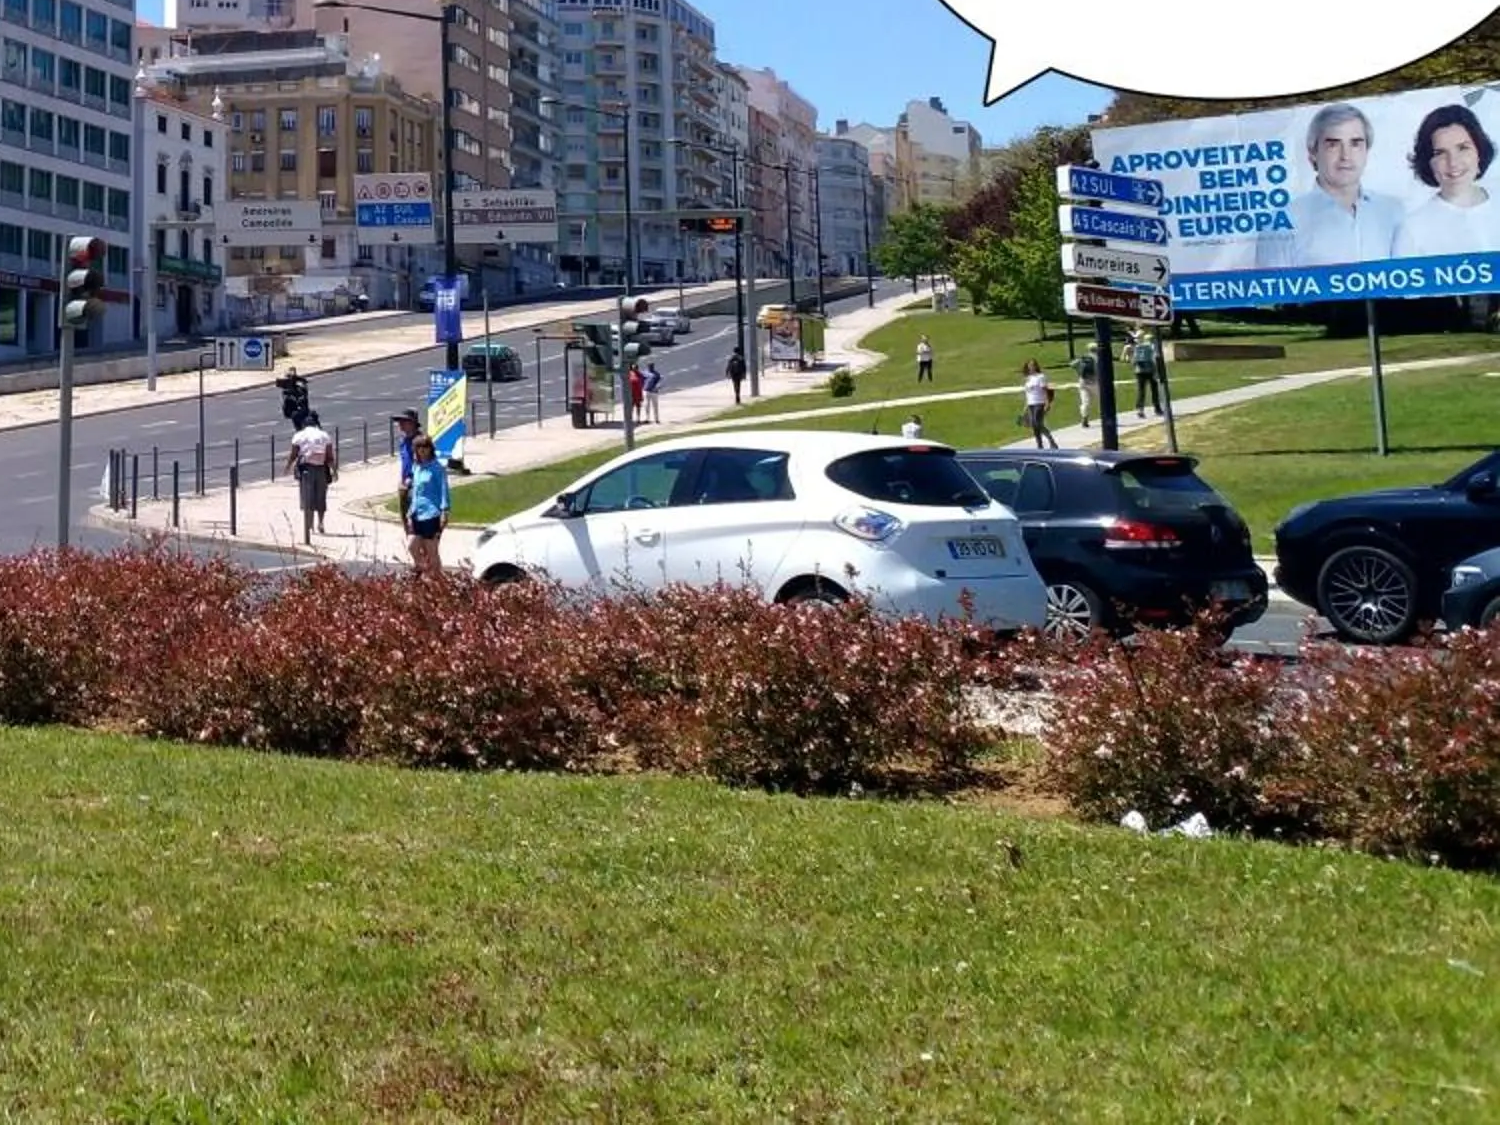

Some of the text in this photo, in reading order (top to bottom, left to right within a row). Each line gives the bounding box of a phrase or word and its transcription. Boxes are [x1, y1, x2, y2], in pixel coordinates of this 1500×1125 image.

[1110, 141, 1286, 174] APROVEITAR
[1072, 174, 1117, 196] A2 SUL
[1200, 164, 1288, 190] BEM O
[1157, 188, 1290, 216] DINHEIRO
[1091, 216, 1135, 236] Cascais
[1178, 211, 1294, 238] EUROPA
[1077, 252, 1141, 274] Amoreiras
[1330, 268, 1426, 293] SOMOS
[1434, 260, 1493, 286] NÓS
